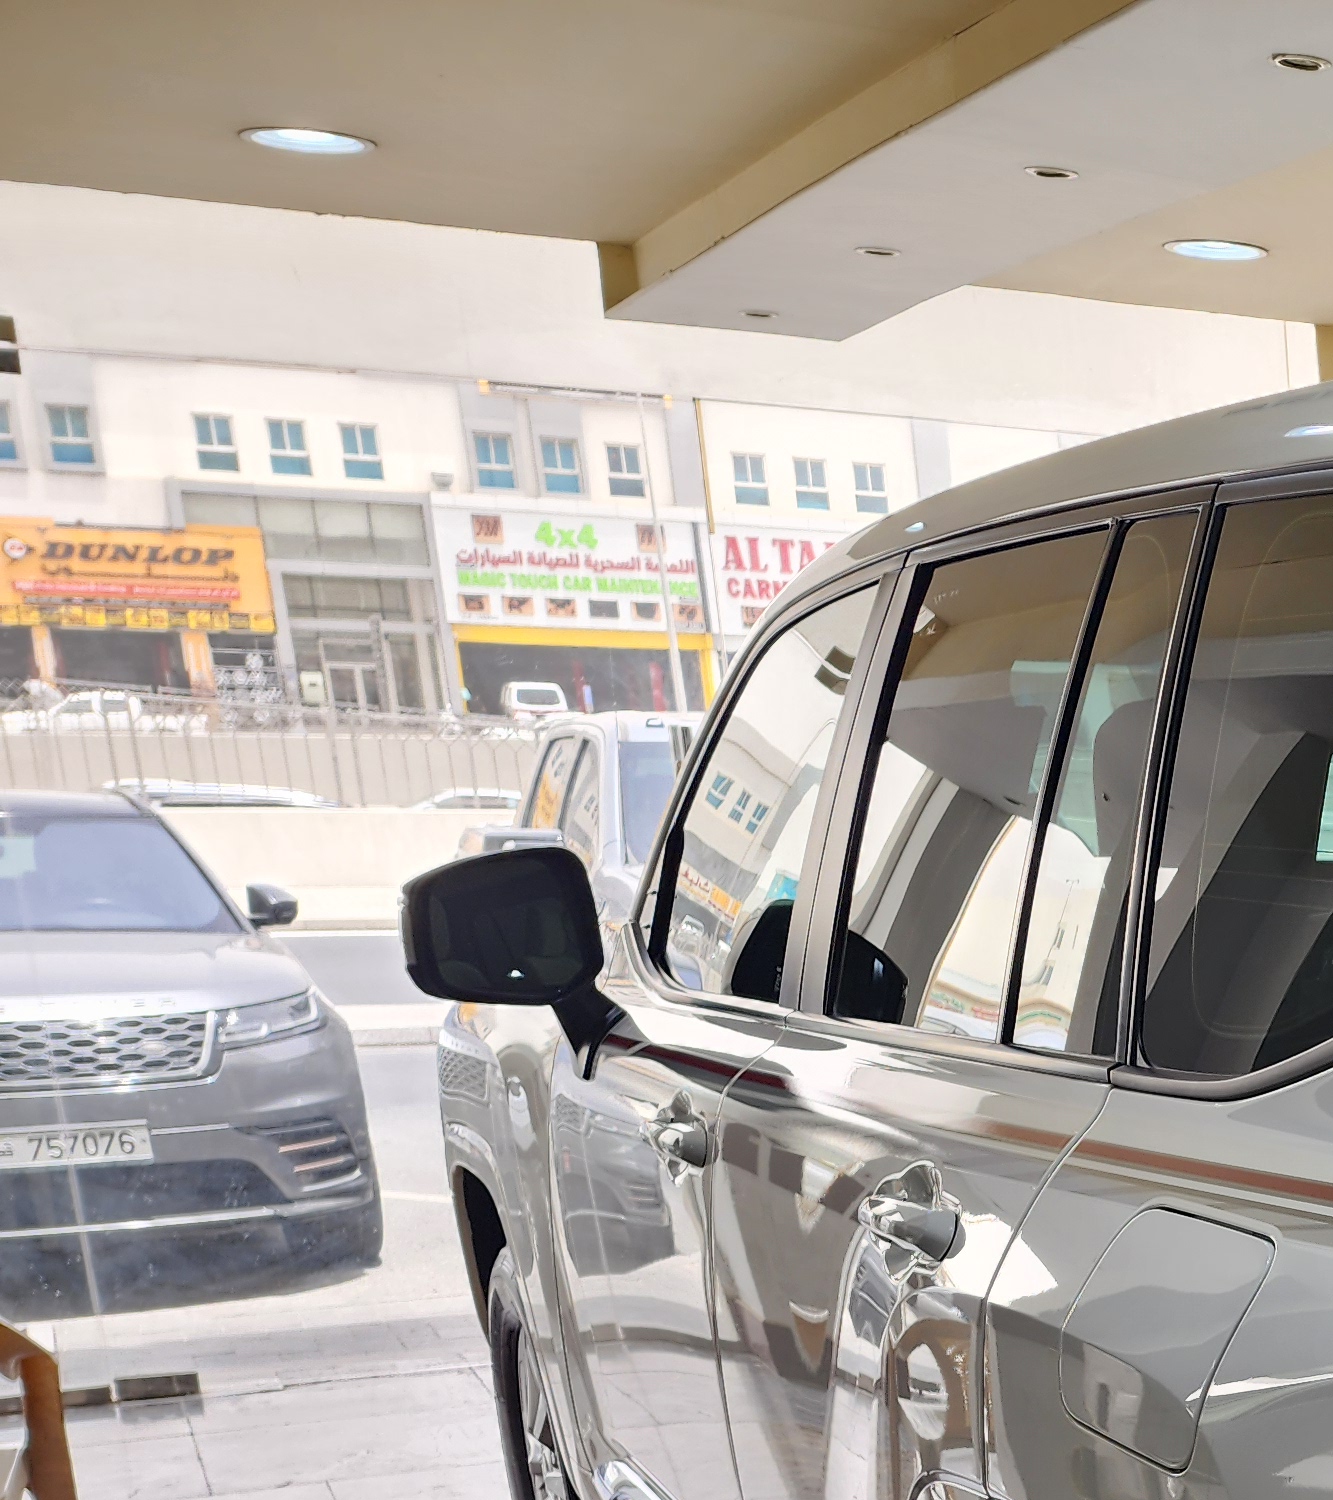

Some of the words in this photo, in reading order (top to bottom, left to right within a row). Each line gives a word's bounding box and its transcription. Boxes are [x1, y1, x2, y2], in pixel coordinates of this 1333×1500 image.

[535, 520, 598, 549] 4x4
[43, 540, 235, 566] DUNLOP
[772, 538, 836, 575] TA
[457, 569, 507, 588] MAGIC
[509, 572, 560, 590] TOUCH
[562, 573, 593, 592] CAR
[597, 576, 697, 598] MAINTENNCE
[28, 1129, 135, 1162] 757076
